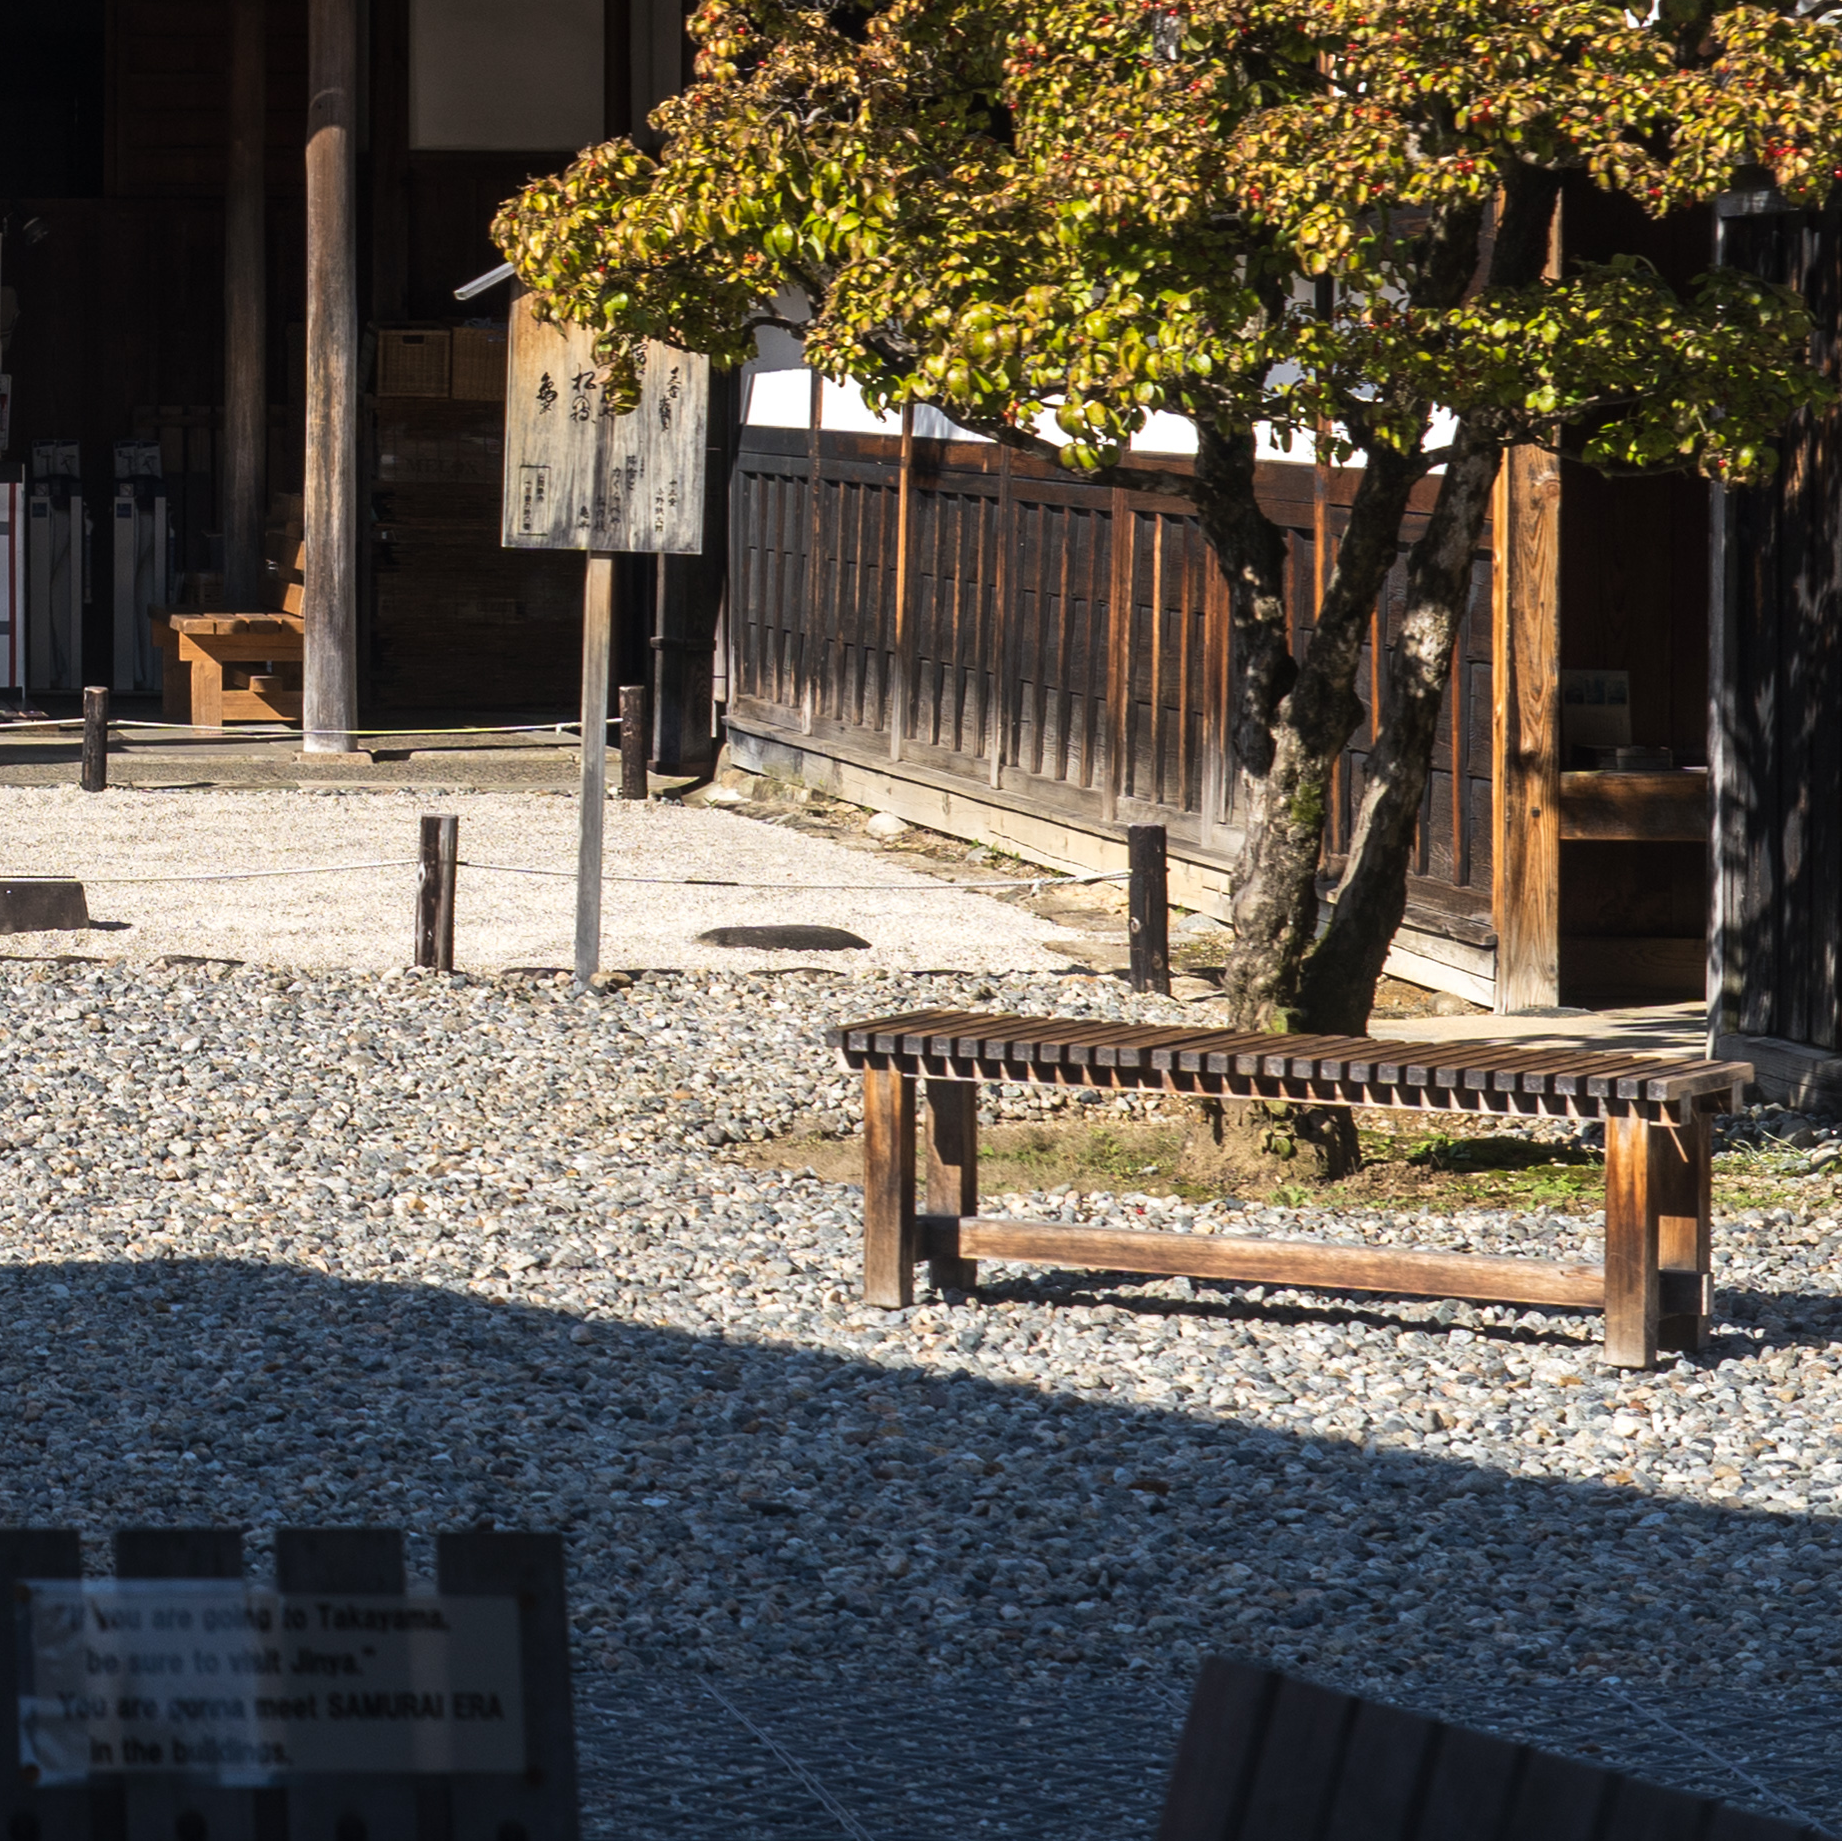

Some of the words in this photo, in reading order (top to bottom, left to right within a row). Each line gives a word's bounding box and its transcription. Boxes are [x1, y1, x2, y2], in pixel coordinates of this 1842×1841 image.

[151, 1607, 193, 1631] are
[202, 1604, 272, 1634] going
[283, 1605, 307, 1631] to
[86, 1649, 119, 1674] be
[128, 1652, 184, 1675] sure
[193, 1650, 219, 1674] to
[228, 1649, 282, 1675] visit
[58, 1692, 106, 1721] You
[116, 1695, 157, 1720] are
[168, 1695, 245, 1725] gonna
[255, 1692, 318, 1719] meet
[327, 1691, 444, 1720] SAMURAI
[452, 1691, 505, 1720] ERA
[89, 1739, 114, 1764] in
[123, 1737, 162, 1764] the
